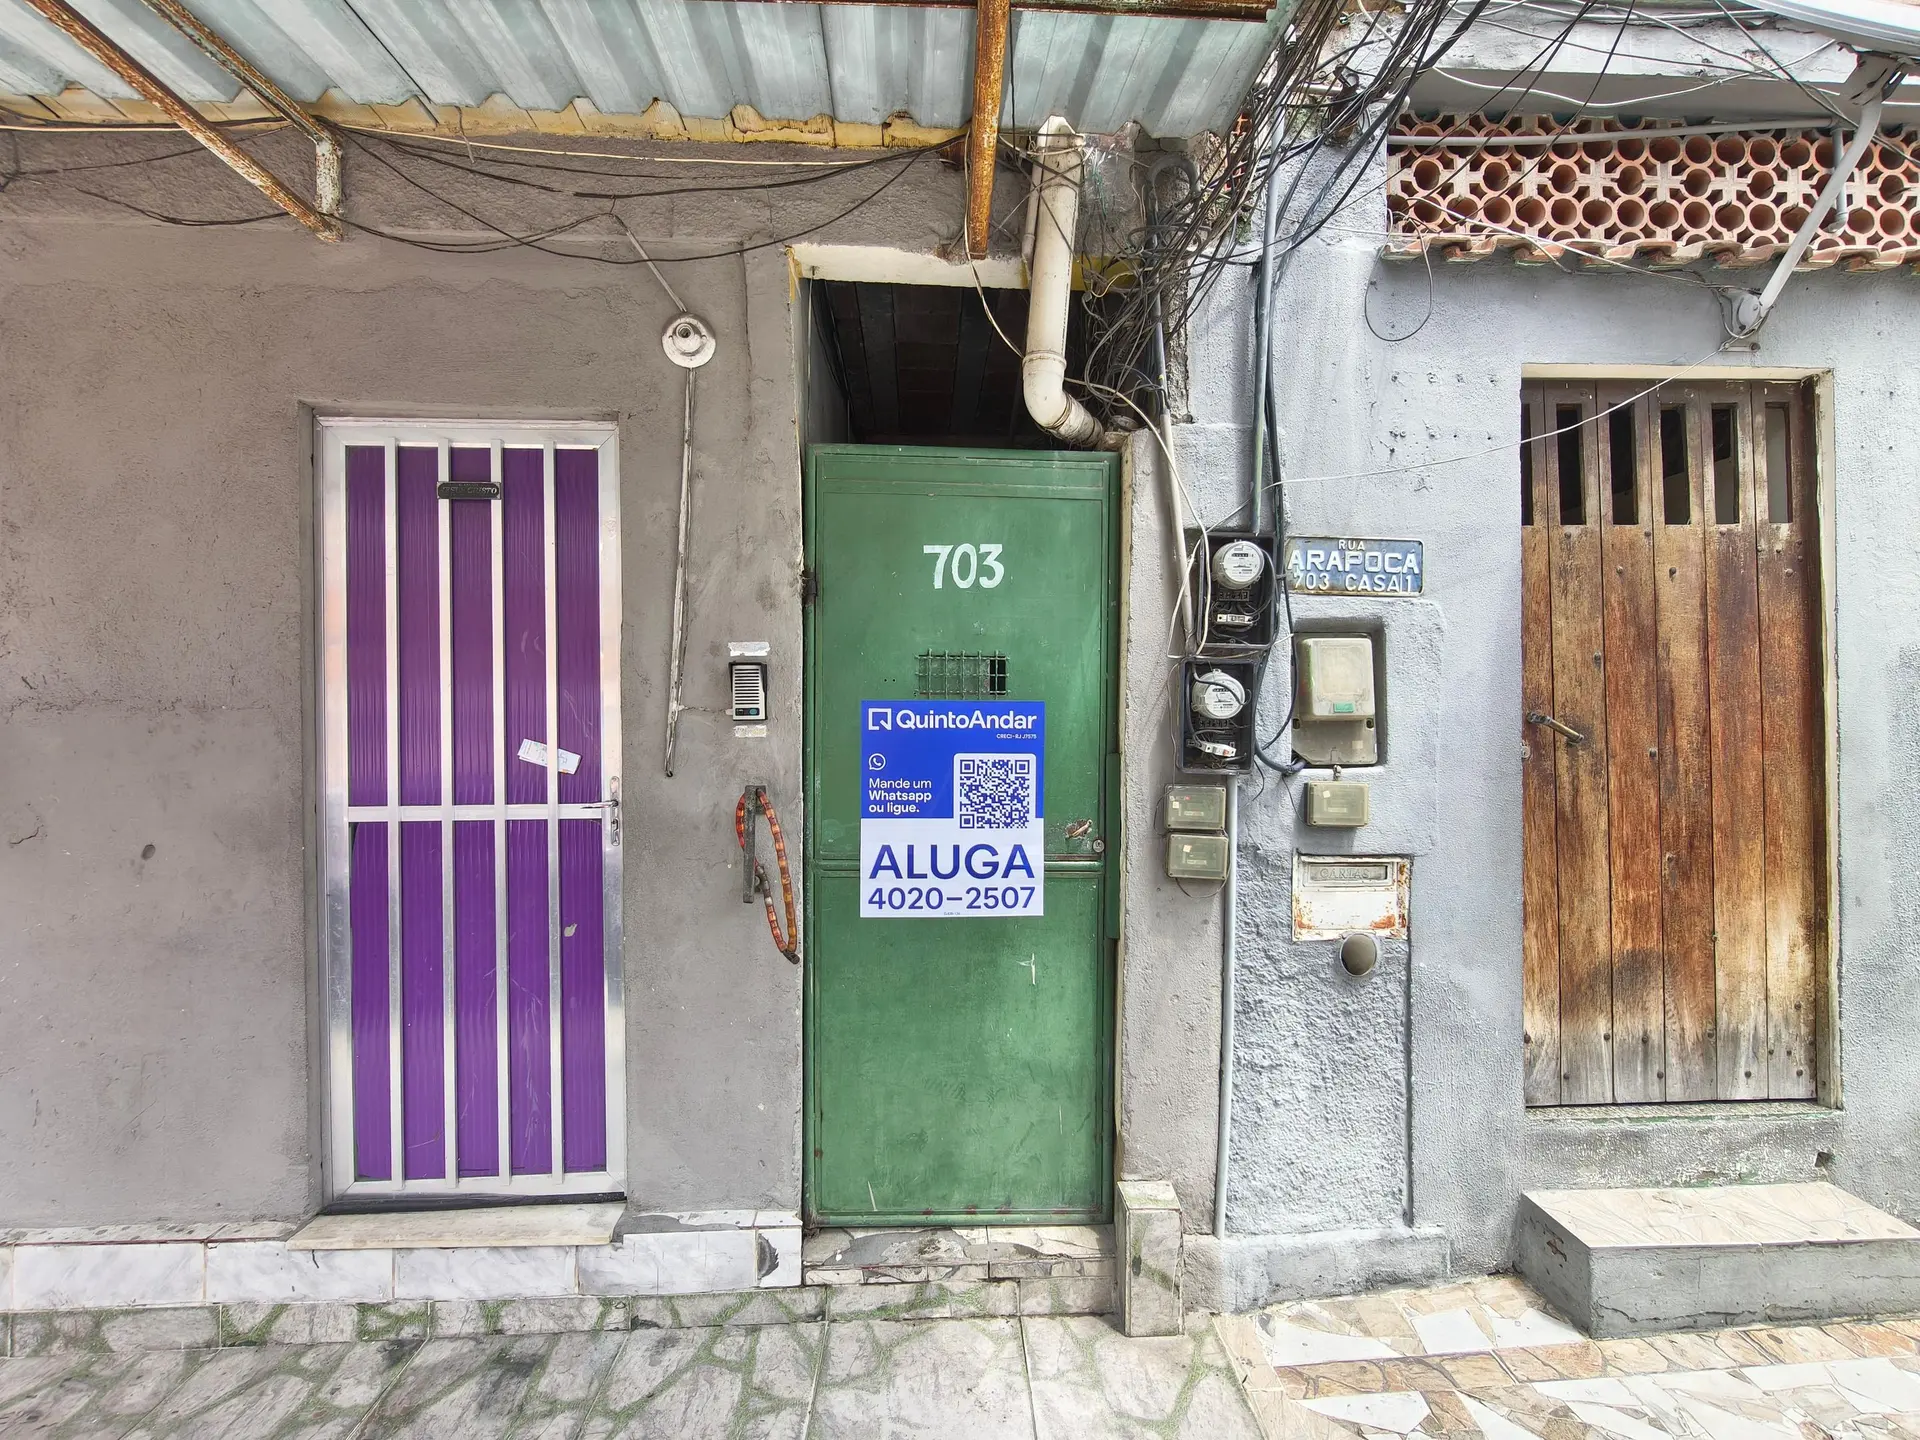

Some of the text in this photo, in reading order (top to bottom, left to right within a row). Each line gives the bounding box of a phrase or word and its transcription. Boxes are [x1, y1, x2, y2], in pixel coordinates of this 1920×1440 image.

[1338, 539, 1366, 550] RUA
[923, 543, 1005, 589] 703
[1293, 571, 1330, 590] 703
[1345, 573, 1400, 592] CASA
[896, 709, 1037, 730] QuintoAndar
[869, 777, 932, 789] Mande um
[868, 789, 932, 803] Whatsapp
[868, 801, 920, 815] ou ligue.
[868, 843, 1035, 880] ALUGA
[1320, 867, 1370, 879] CARTAS
[867, 886, 1036, 910] 4020-2507
